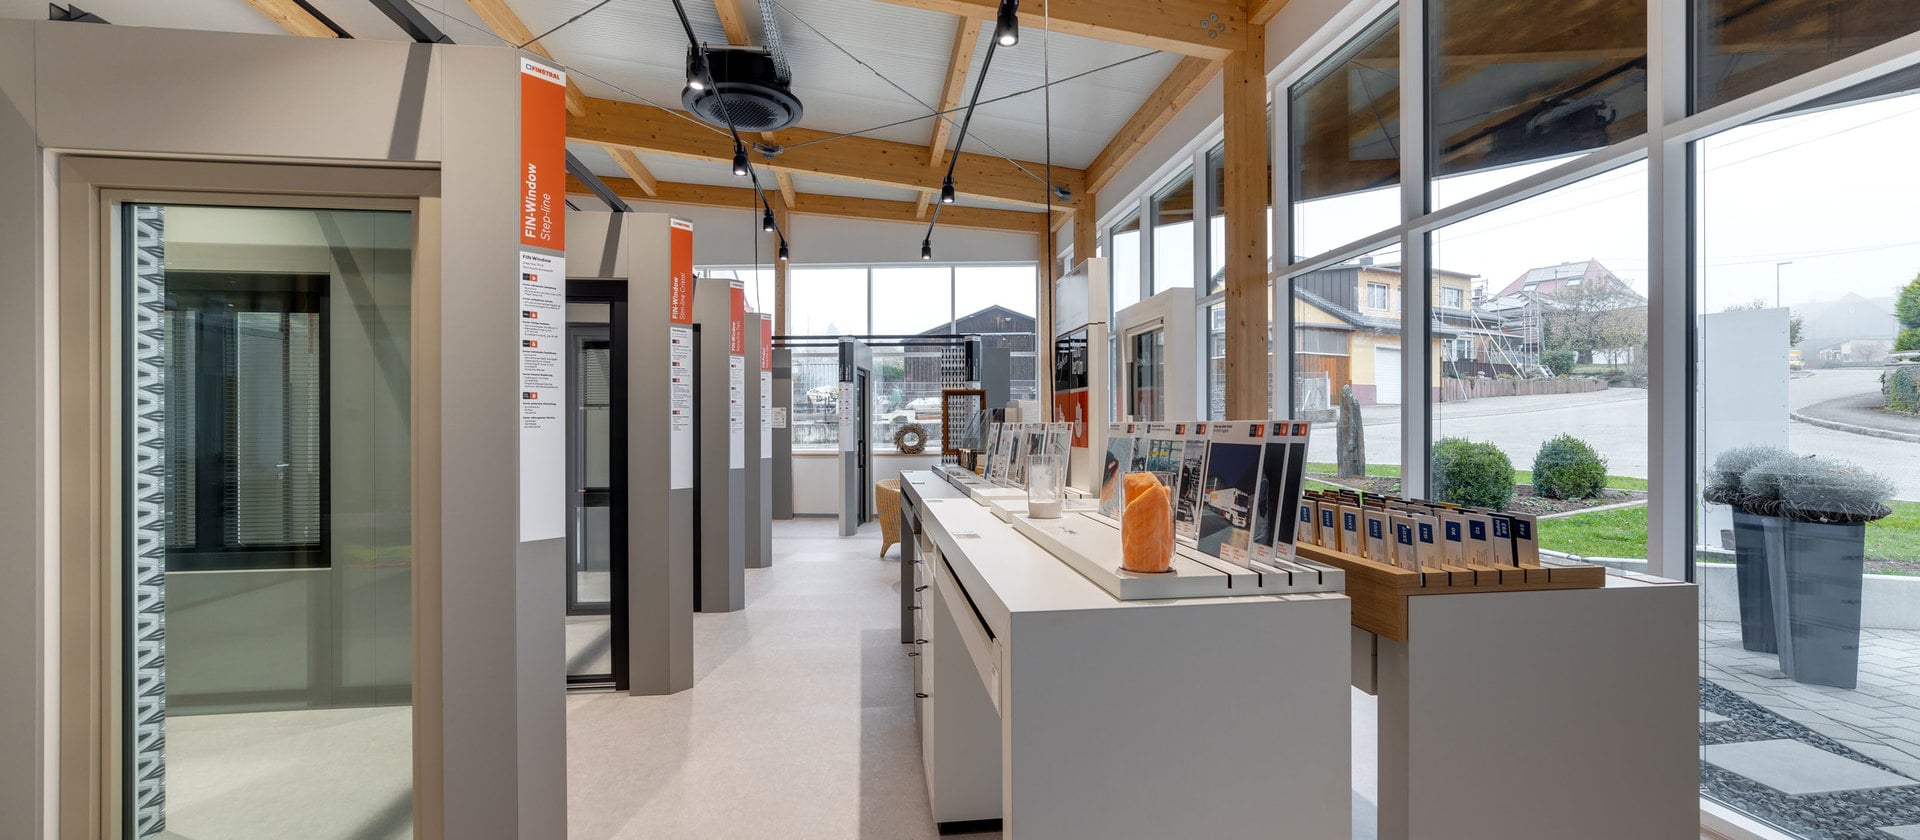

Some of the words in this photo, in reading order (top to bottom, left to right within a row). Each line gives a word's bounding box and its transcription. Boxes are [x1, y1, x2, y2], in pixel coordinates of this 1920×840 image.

[531, 65, 560, 81] FINSTRAL
[525, 162, 537, 238] FIN-Window
[540, 193, 552, 241] Step-line
